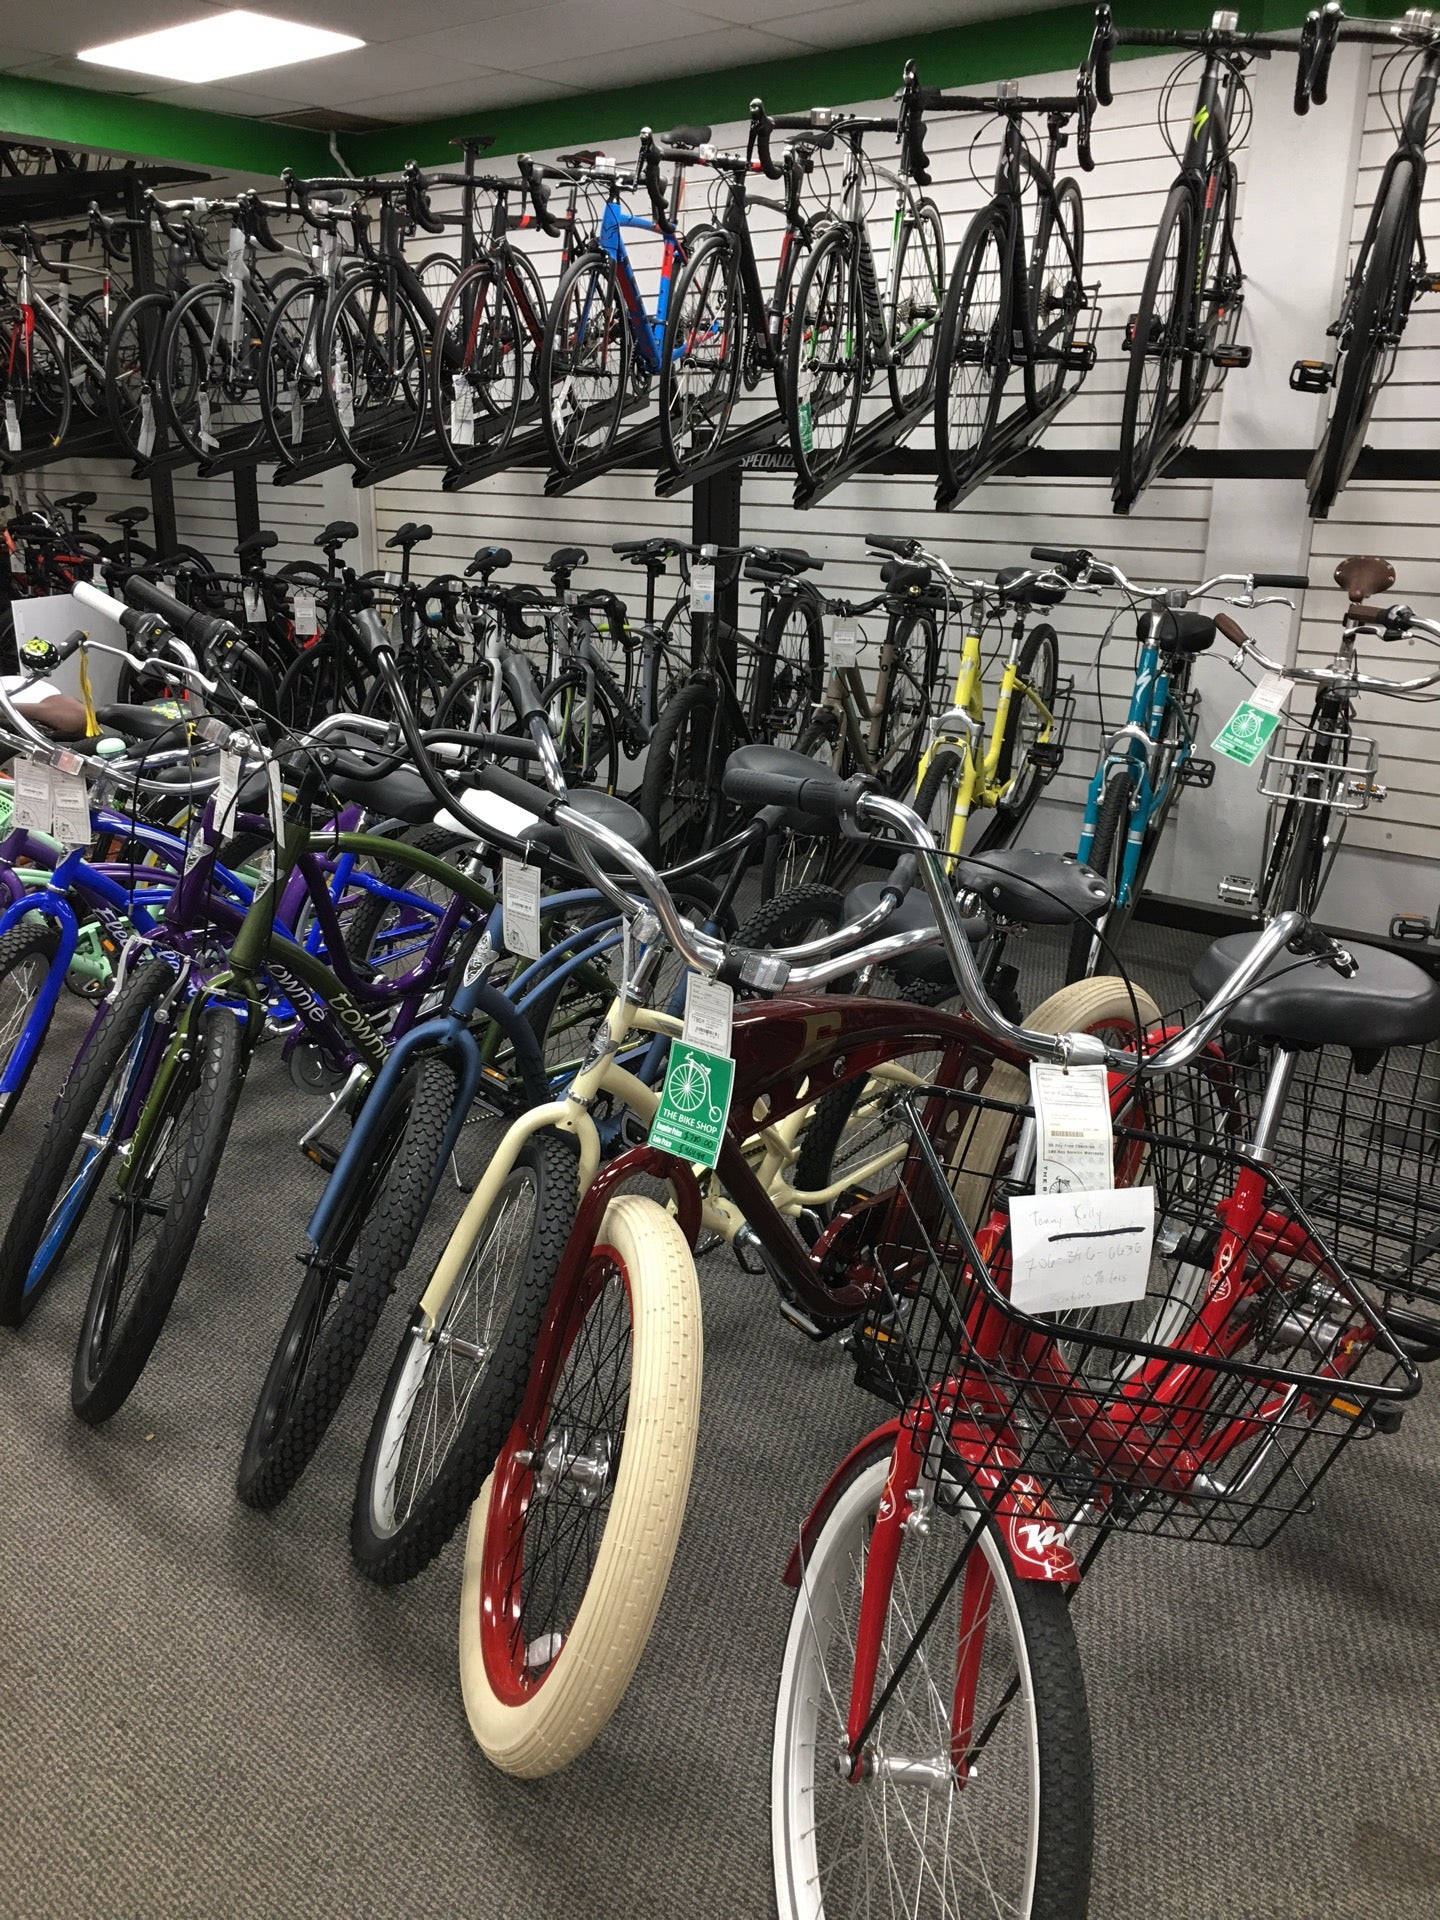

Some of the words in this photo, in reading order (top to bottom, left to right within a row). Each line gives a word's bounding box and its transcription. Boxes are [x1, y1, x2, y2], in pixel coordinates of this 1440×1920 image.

[738, 453, 796, 468] SPECIALIZ
[269, 964, 327, 1022] ownie
[663, 1108, 678, 1120] THE
[678, 1113, 696, 1127] BIKE
[696, 1120, 717, 1134] SHOP
[656, 1122, 672, 1134] Regular
[671, 1127, 683, 1137] Price
[652, 1136, 662, 1145] Sale
[662, 1139, 672, 1147] Price
